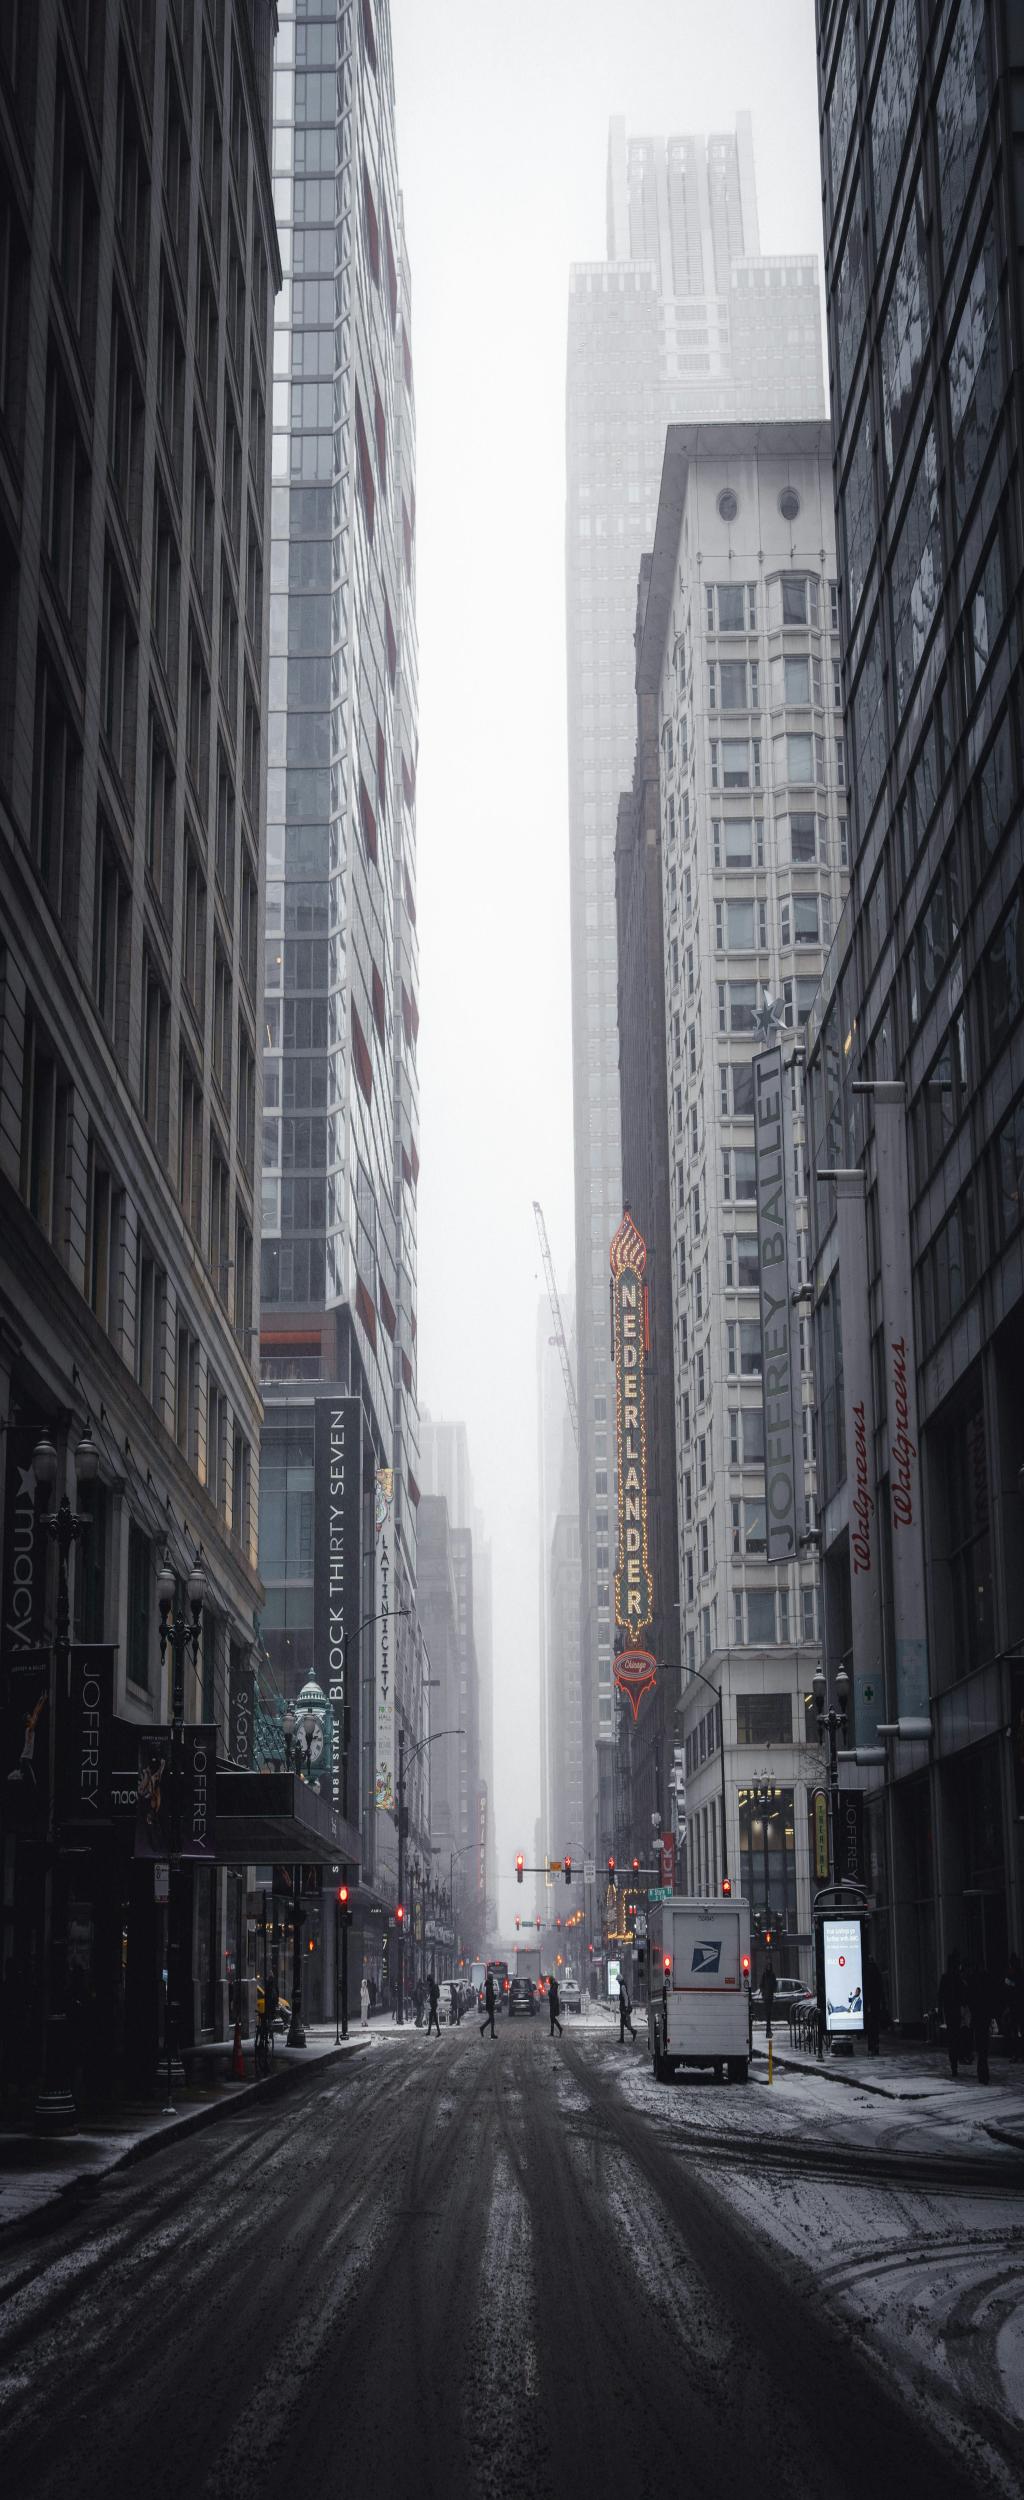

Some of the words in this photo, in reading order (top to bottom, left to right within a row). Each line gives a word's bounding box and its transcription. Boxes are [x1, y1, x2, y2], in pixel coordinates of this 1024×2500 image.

[756, 1063, 785, 1268] BALLET
[330, 1410, 345, 1496] SEVEN
[621, 1284, 642, 1615] NEDERLANDER
[762, 1289, 794, 1553] JOFFREY
[893, 1335, 918, 1532] Walgreens
[853, 1399, 871, 1576] Walgreens
[329, 1505, 345, 1598] THIRTY
[329, 1607, 344, 1700] BLOCK
[380, 1535, 389, 1701] LATINICITY
[624, 1659, 647, 1672] Chicago
[80, 1662, 102, 1809] JOFFREY
[332, 1720, 340, 1760] STATE
[332, 1765, 340, 1773] N
[192, 1737, 208, 1848] JOFFREY
[846, 1799, 858, 1880] JOFFREY
